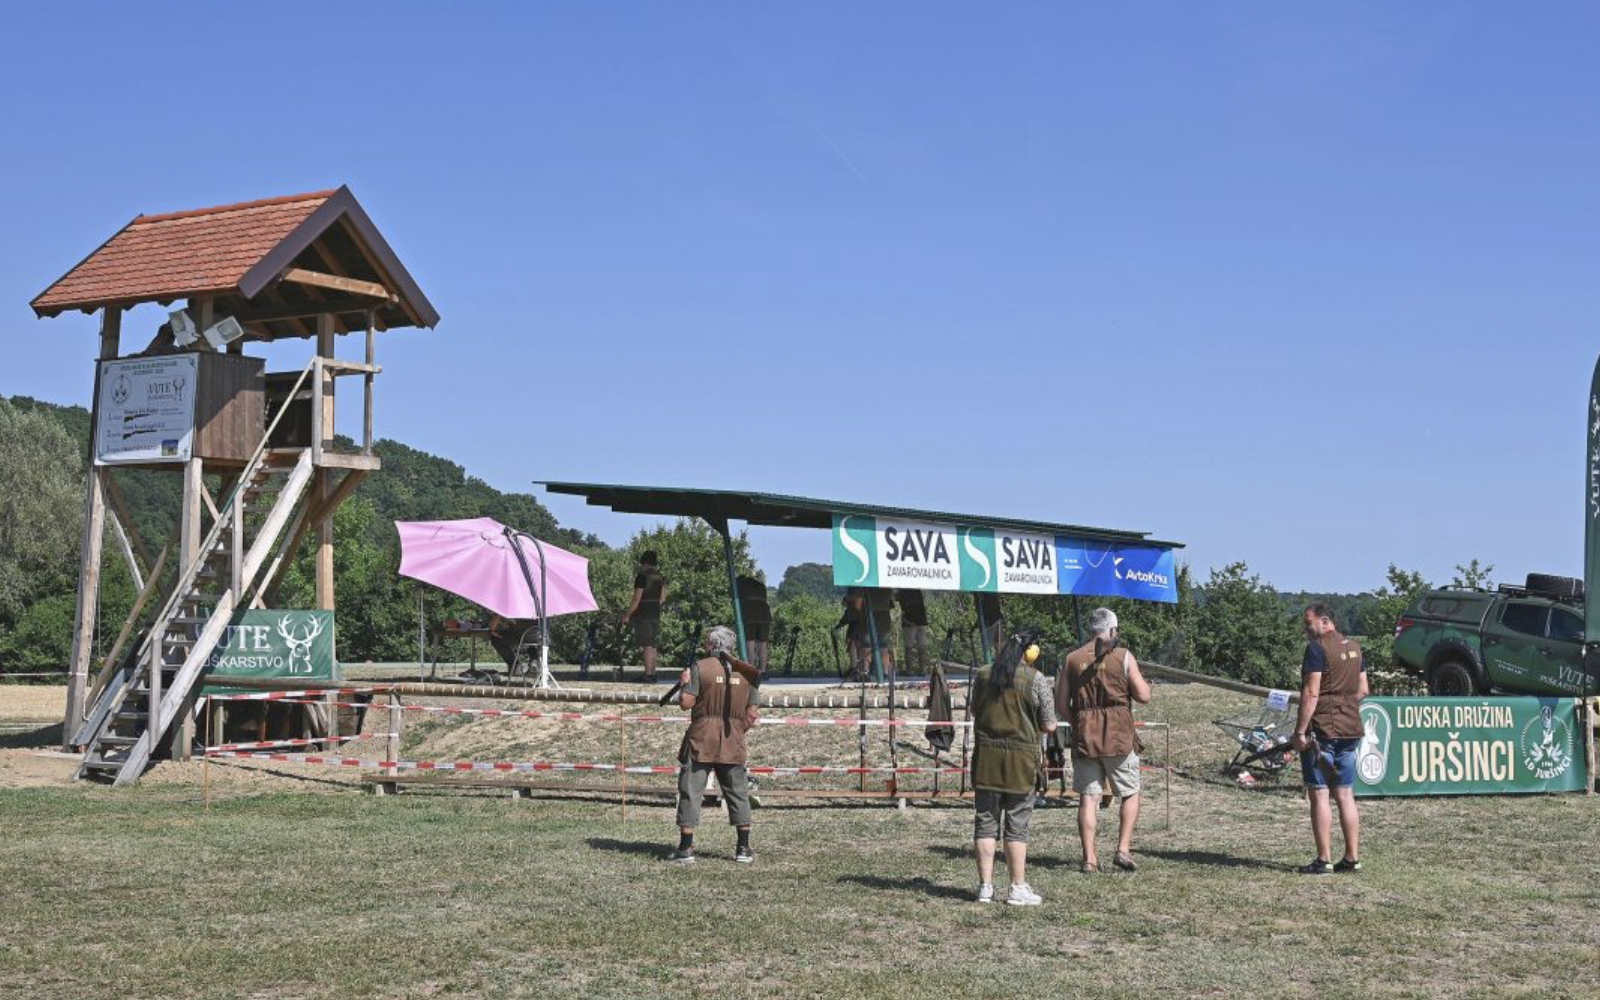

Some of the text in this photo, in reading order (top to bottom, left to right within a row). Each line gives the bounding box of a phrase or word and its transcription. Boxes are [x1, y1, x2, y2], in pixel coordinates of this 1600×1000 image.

[884, 526, 951, 564] SAVA
[1002, 536, 1053, 571] SAVA
[887, 565, 953, 580] ZAVAROVALNICA
[1397, 702, 1514, 729] LOVSKA DRUŽINA
[1399, 731, 1515, 783] JURŠINCI
